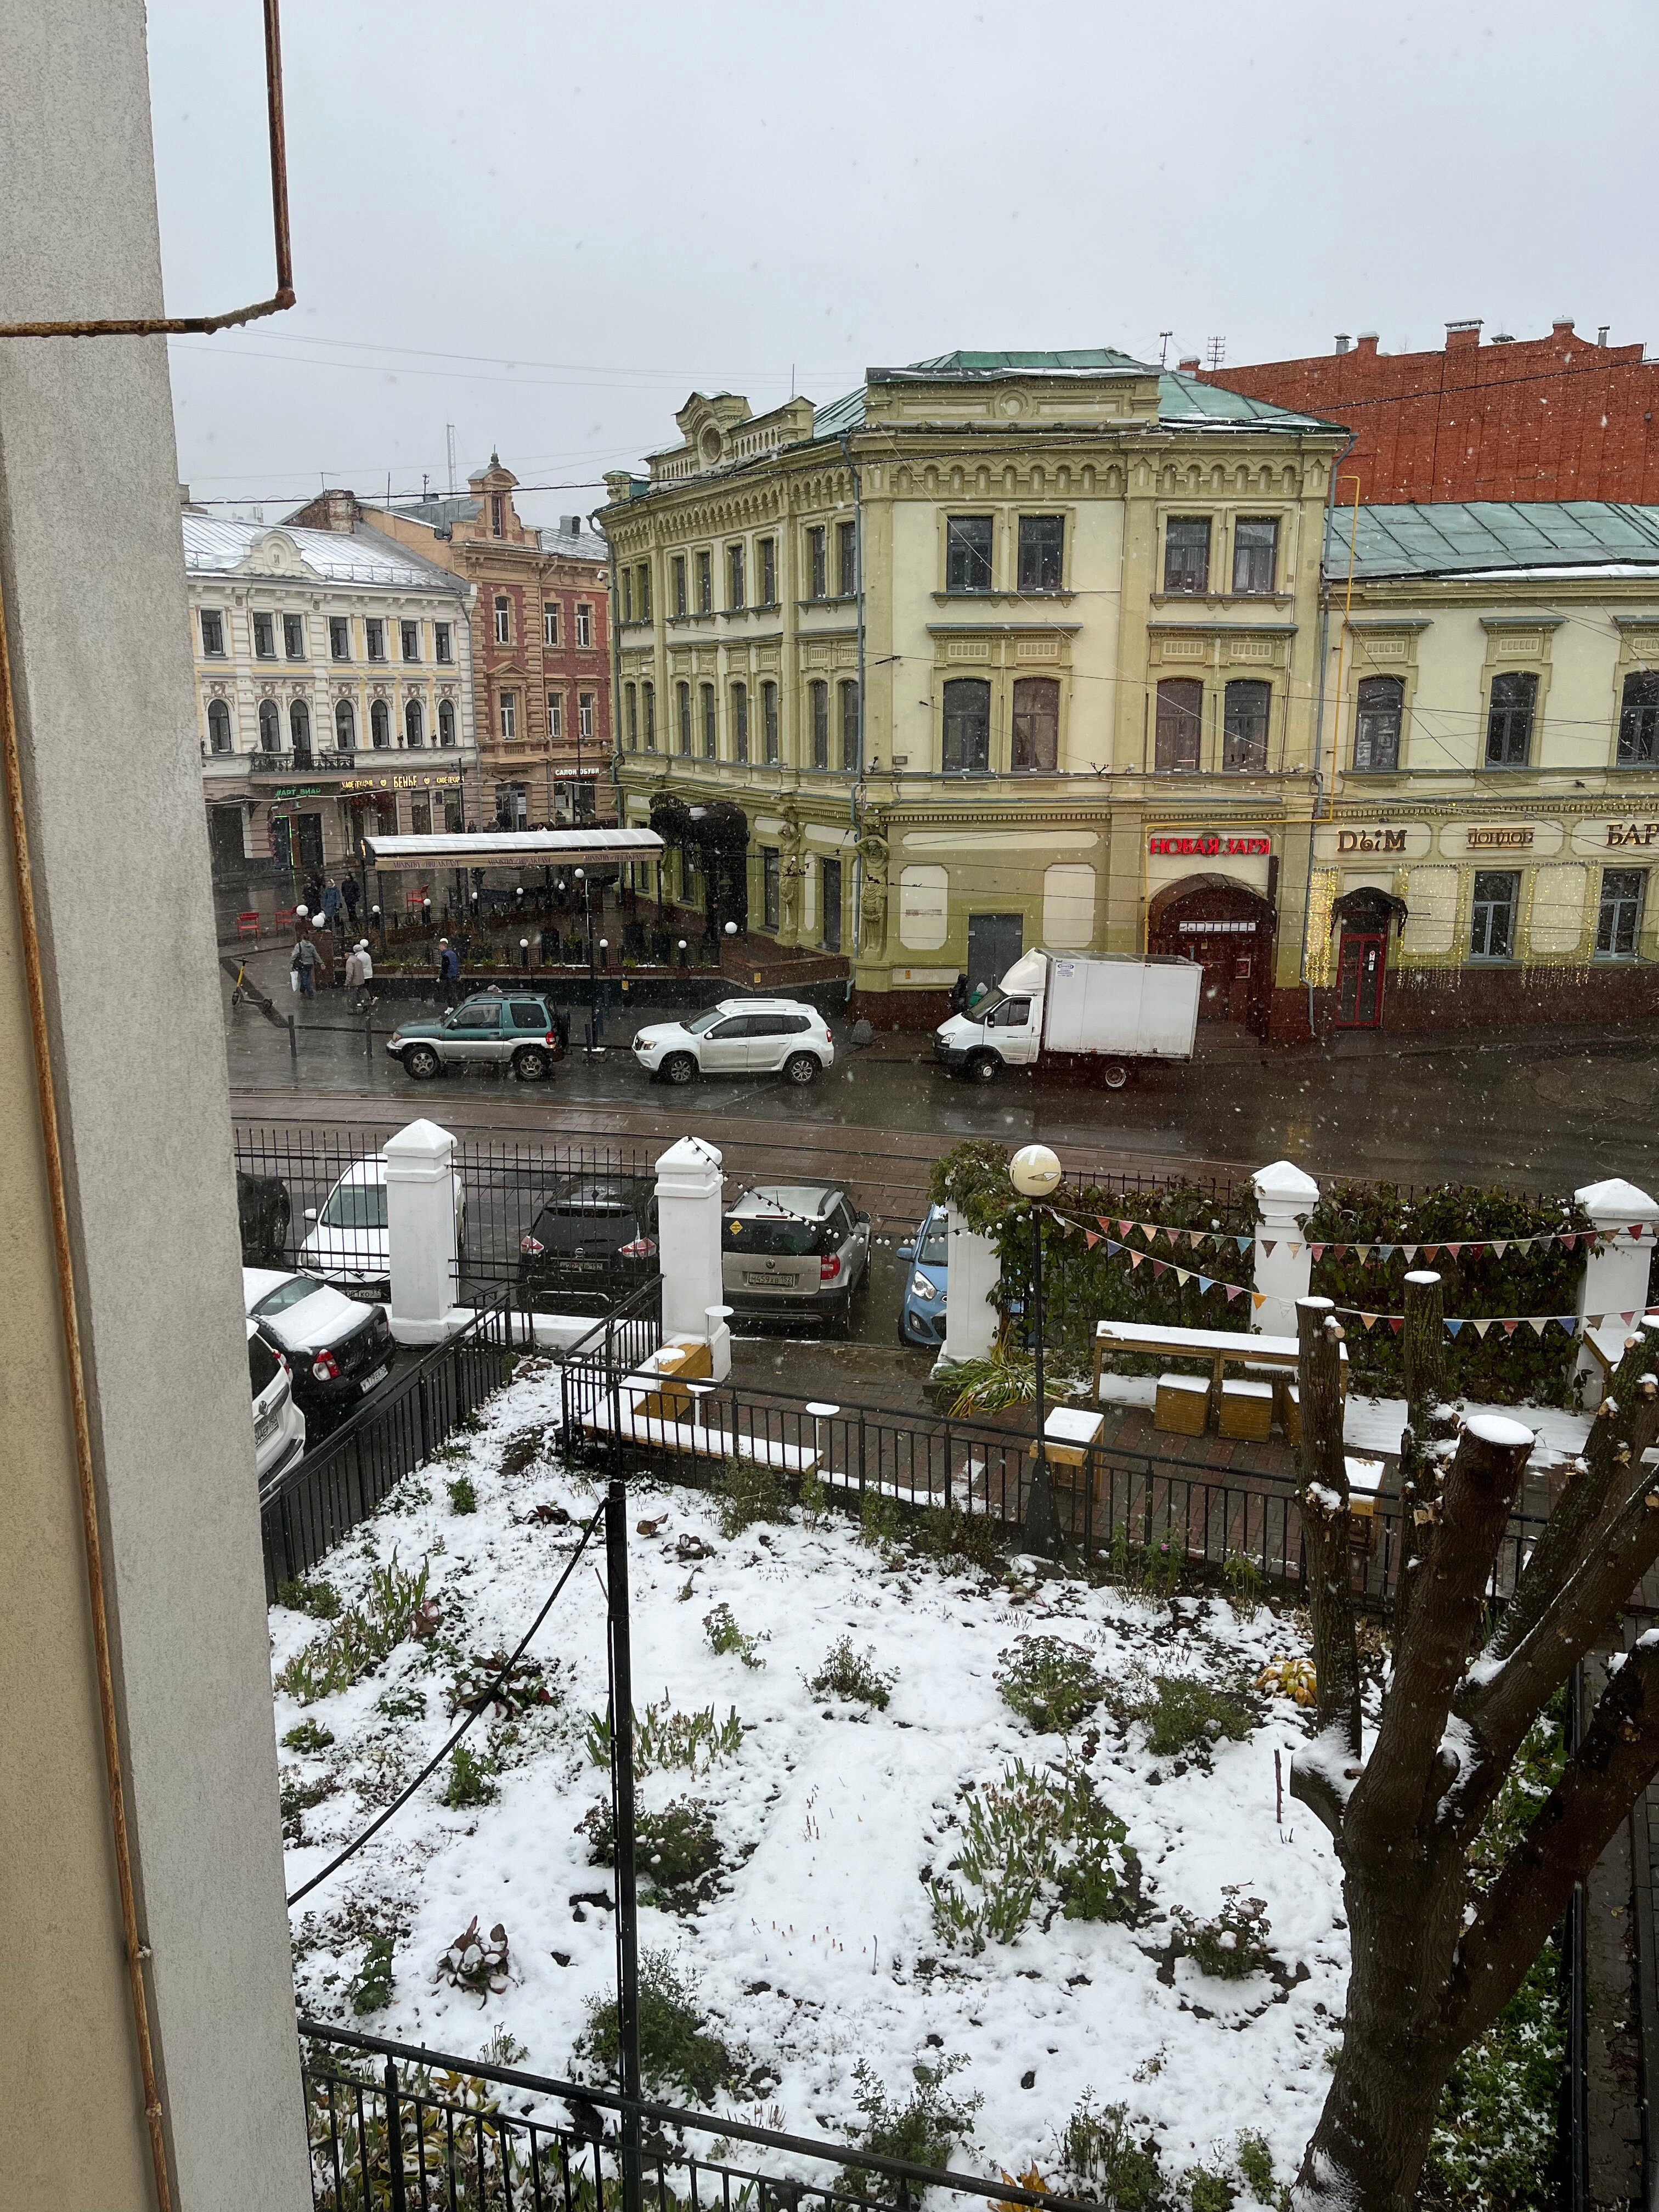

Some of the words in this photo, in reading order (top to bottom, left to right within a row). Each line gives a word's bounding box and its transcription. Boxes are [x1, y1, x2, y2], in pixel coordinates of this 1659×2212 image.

[393, 776, 417, 788] БЕНЬЕ
[1606, 824, 1659, 845] БАР
[1150, 838, 1219, 854] НОВАЯ
[1222, 838, 1269, 855] ЗАРЯ
